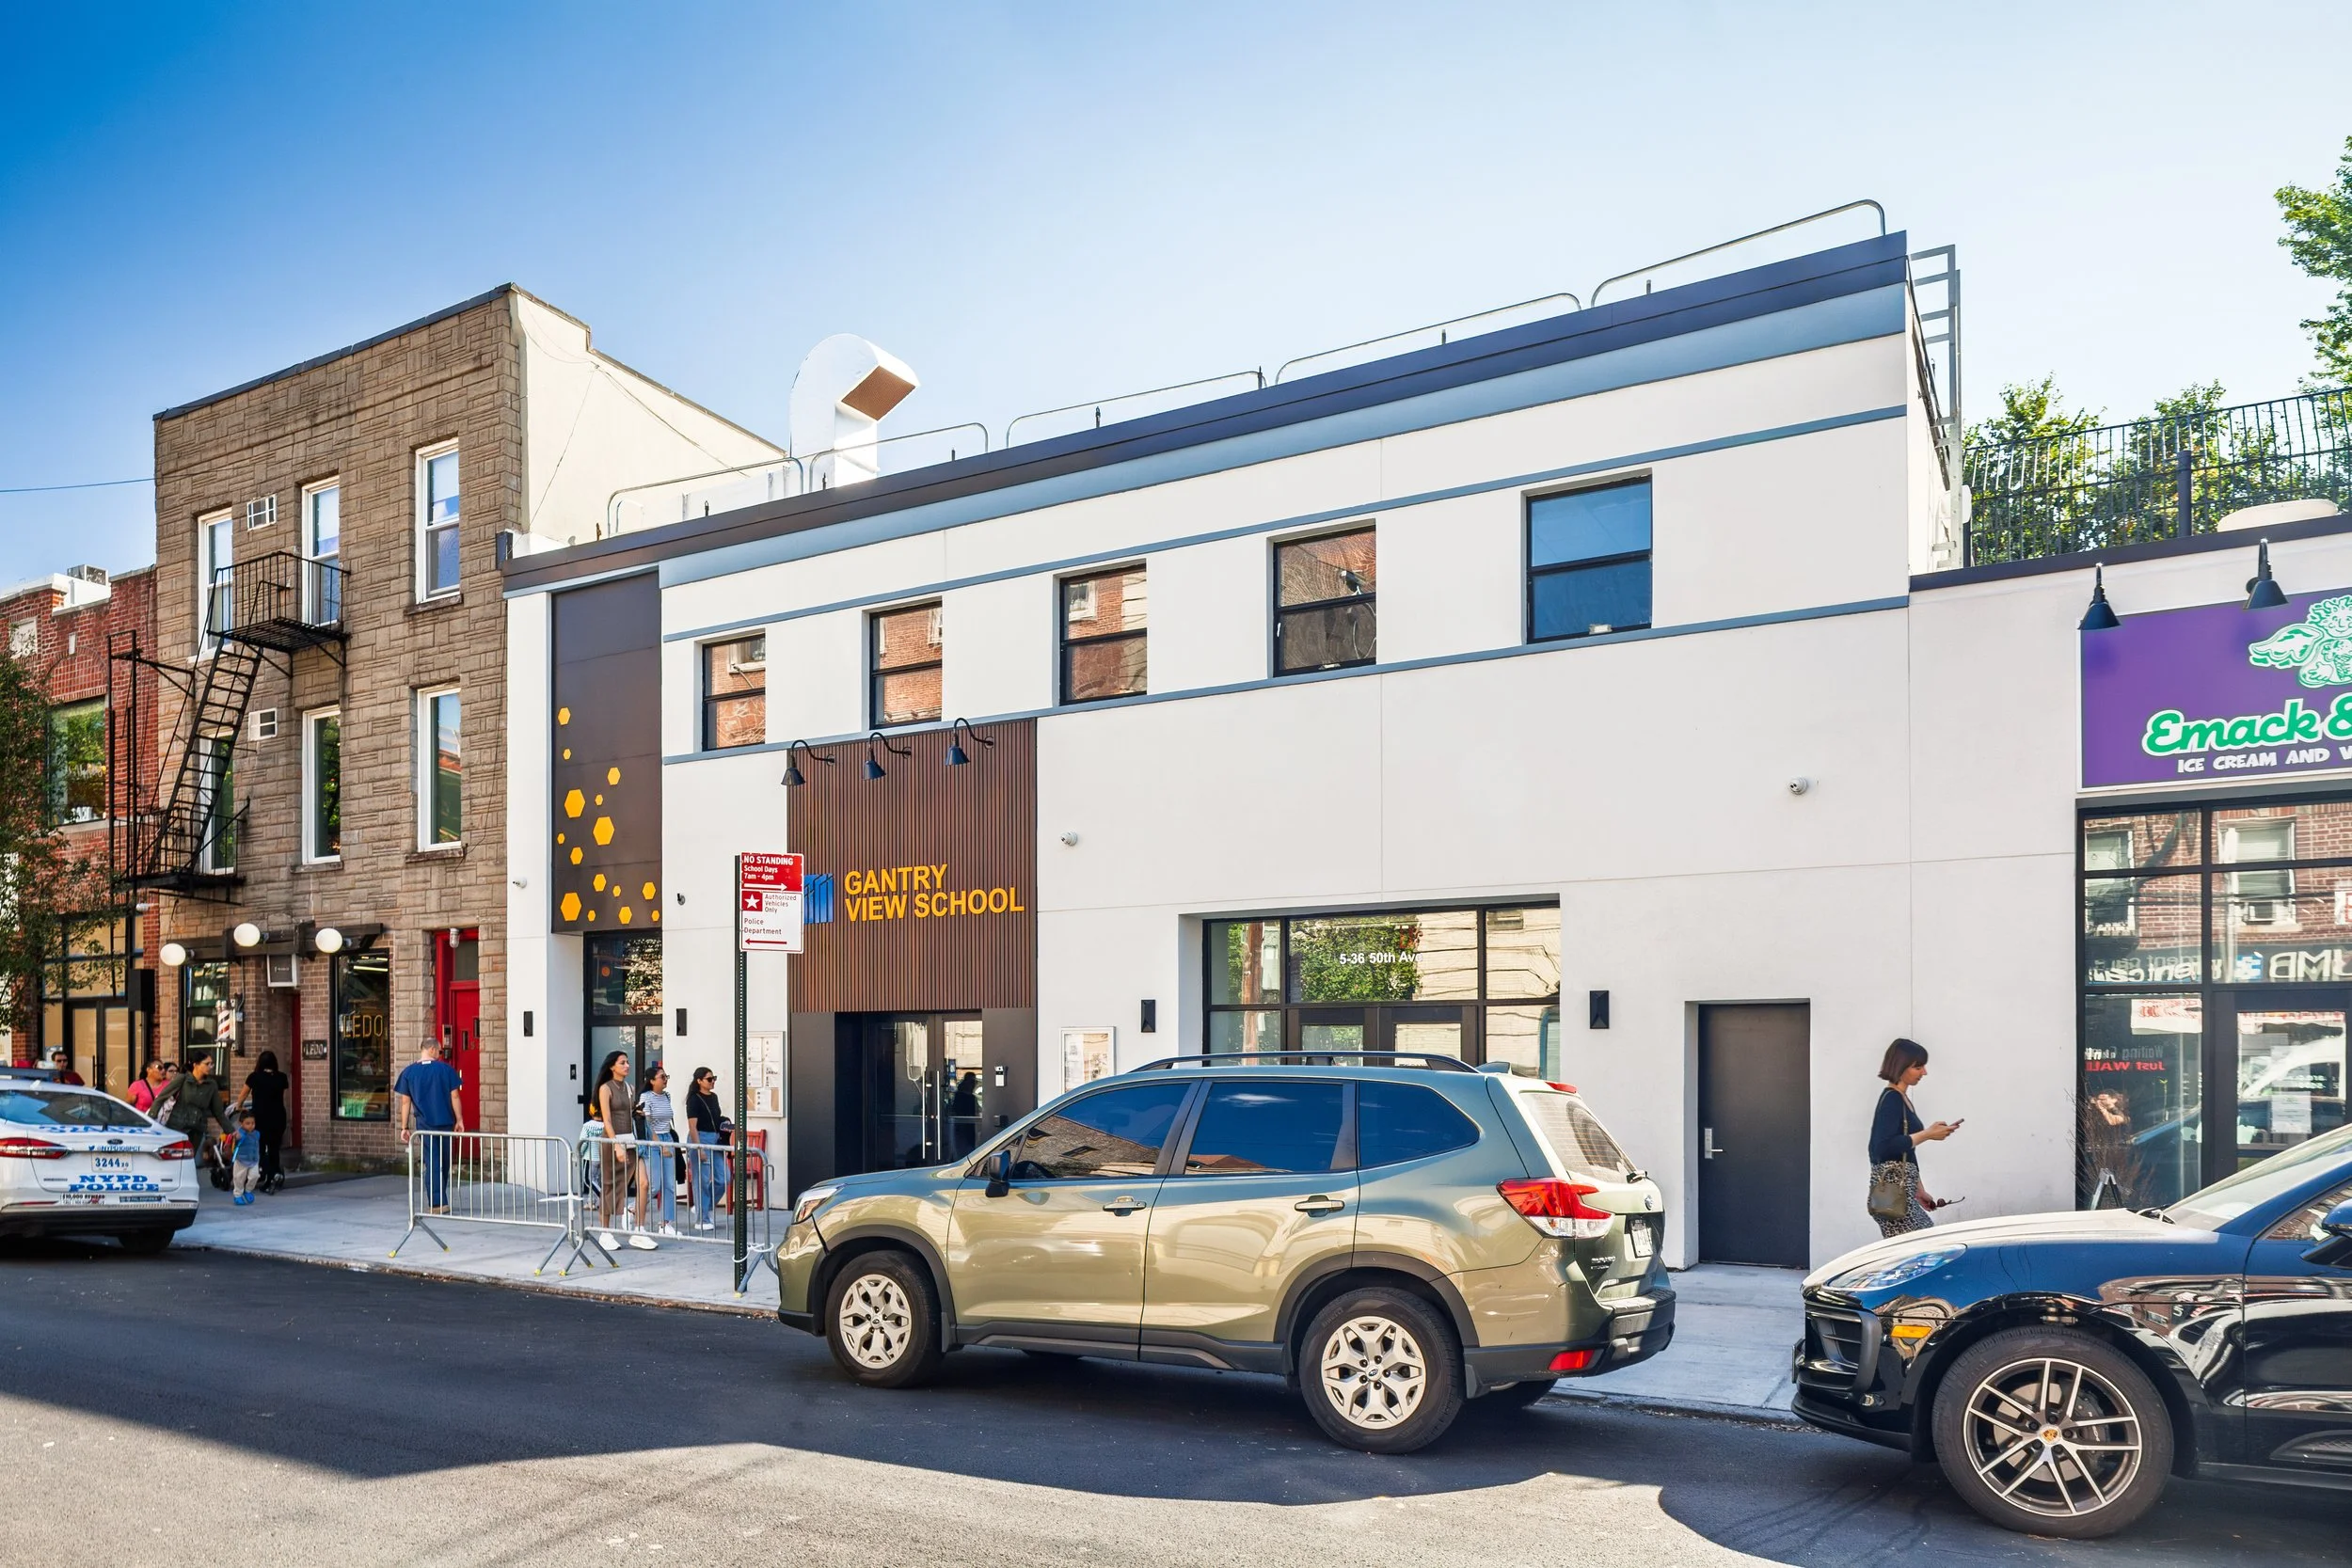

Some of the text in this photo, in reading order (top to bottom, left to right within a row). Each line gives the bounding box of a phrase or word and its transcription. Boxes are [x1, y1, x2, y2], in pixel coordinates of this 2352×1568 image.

[2143, 699, 2321, 755] Emack
[2177, 757, 2204, 773] ICE
[2213, 752, 2277, 770] CREAM
[2285, 748, 2330, 765] AND
[756, 857, 793, 865] STANDING
[845, 863, 947, 895] GANTRY
[845, 887, 1025, 922] VIEW SCHOOL
[1340, 951, 1423, 964] 5-36 50th Ave
[342, 1015, 383, 1038] LEDO
[306, 1044, 324, 1054] LEDO
[95, 1157, 120, 1167] 3244
[68, 1183, 159, 1193] POLICE
